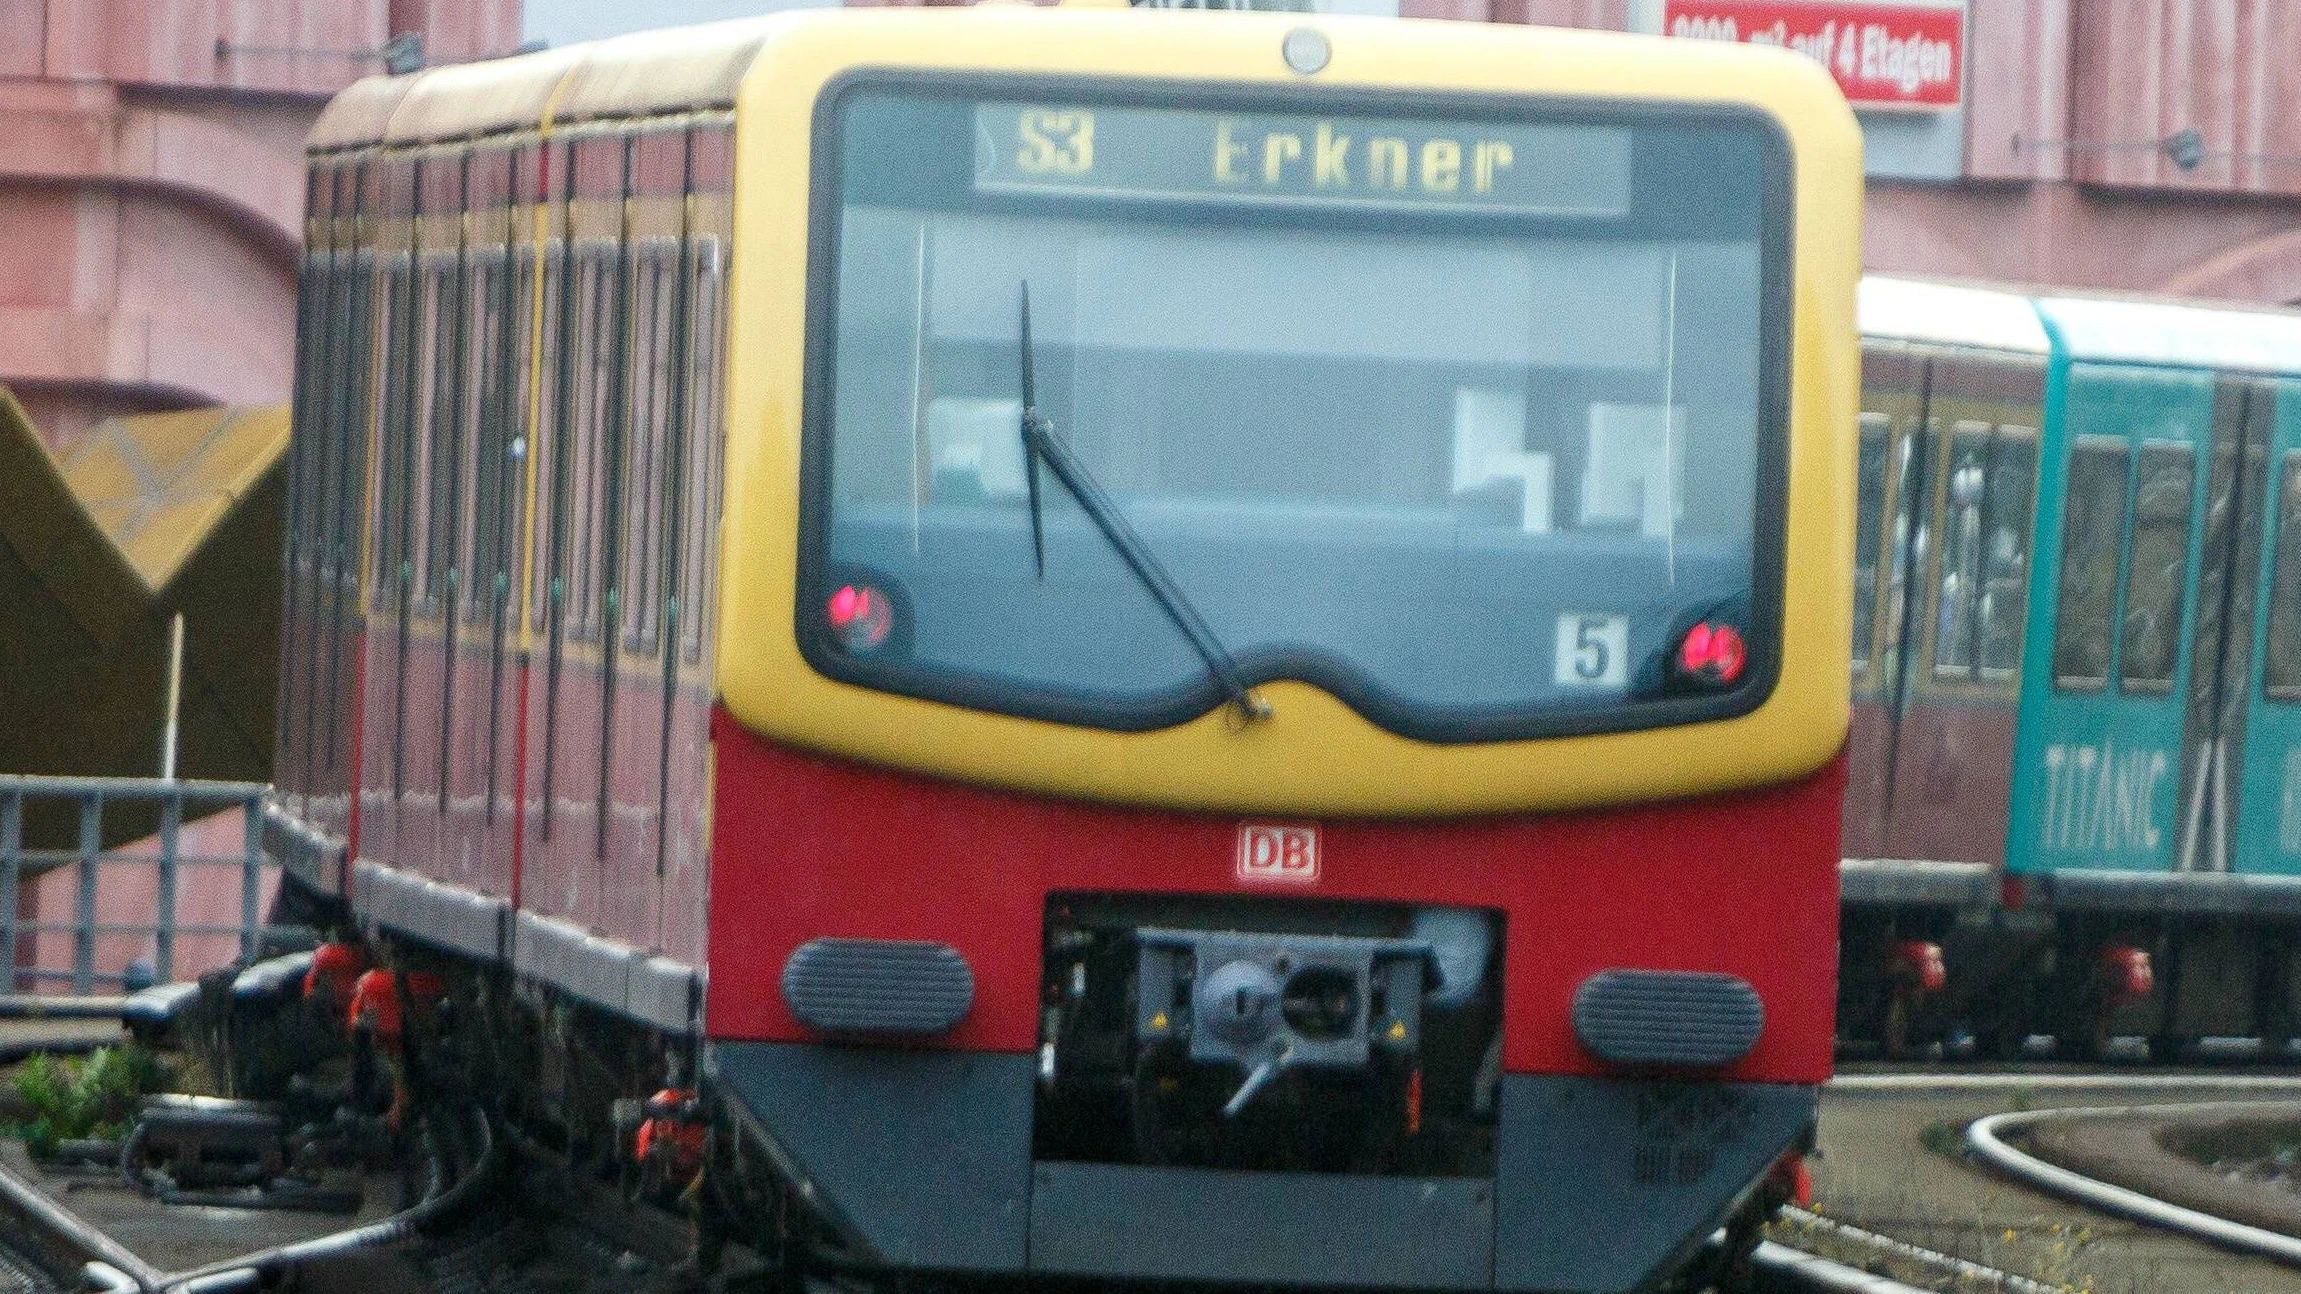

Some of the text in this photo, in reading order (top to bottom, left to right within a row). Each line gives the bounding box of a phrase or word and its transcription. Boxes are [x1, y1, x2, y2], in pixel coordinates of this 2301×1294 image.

[1861, 24, 1951, 93] Etagen
[1016, 108, 1515, 194] S3 Erkner
[1574, 617, 1610, 680] 5
[1249, 831, 1310, 870] DB
